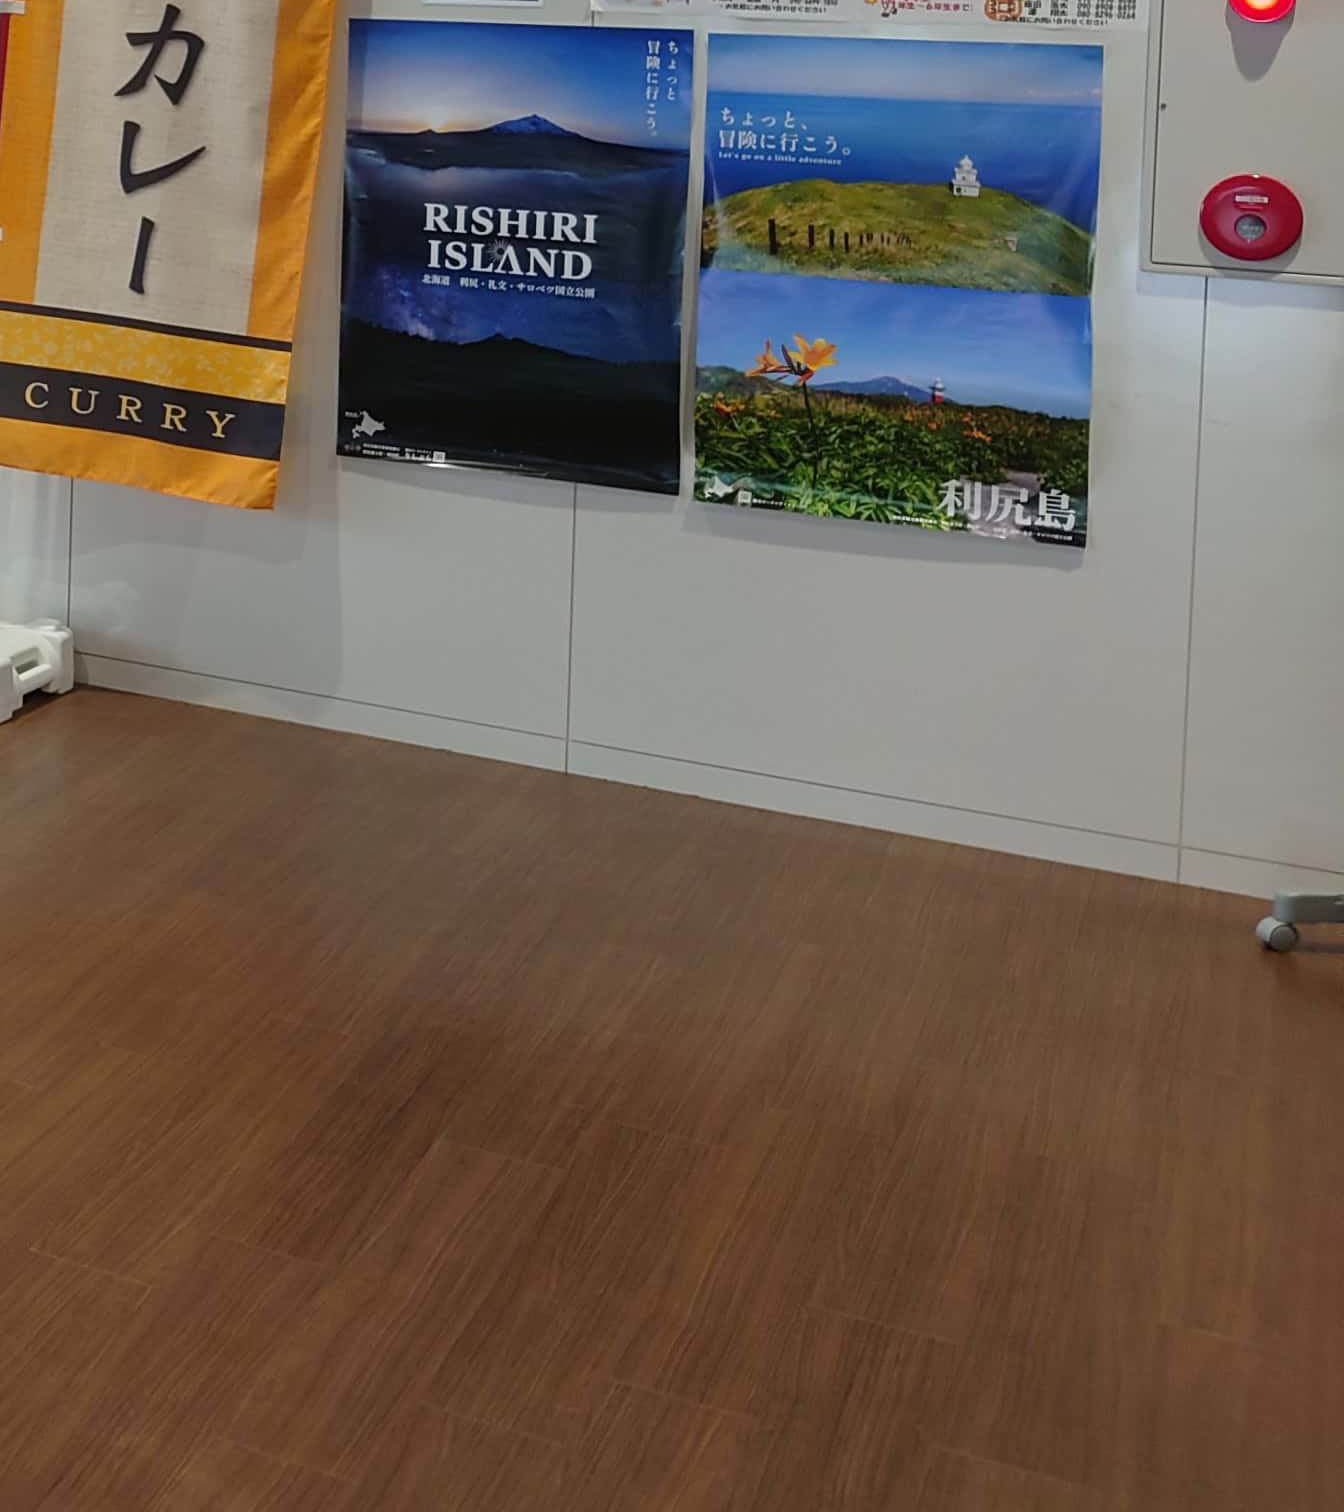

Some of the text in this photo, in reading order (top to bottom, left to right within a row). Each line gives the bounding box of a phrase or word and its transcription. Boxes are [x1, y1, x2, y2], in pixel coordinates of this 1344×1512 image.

[666, 40, 680, 101] ちょっと
[719, 129, 851, 156] 冒険に行こう。
[423, 203, 600, 244] RISHIRI
[427, 239, 593, 280] ISLAND
[24, 382, 236, 438] CURRY
[935, 478, 1077, 532] 利尻島
